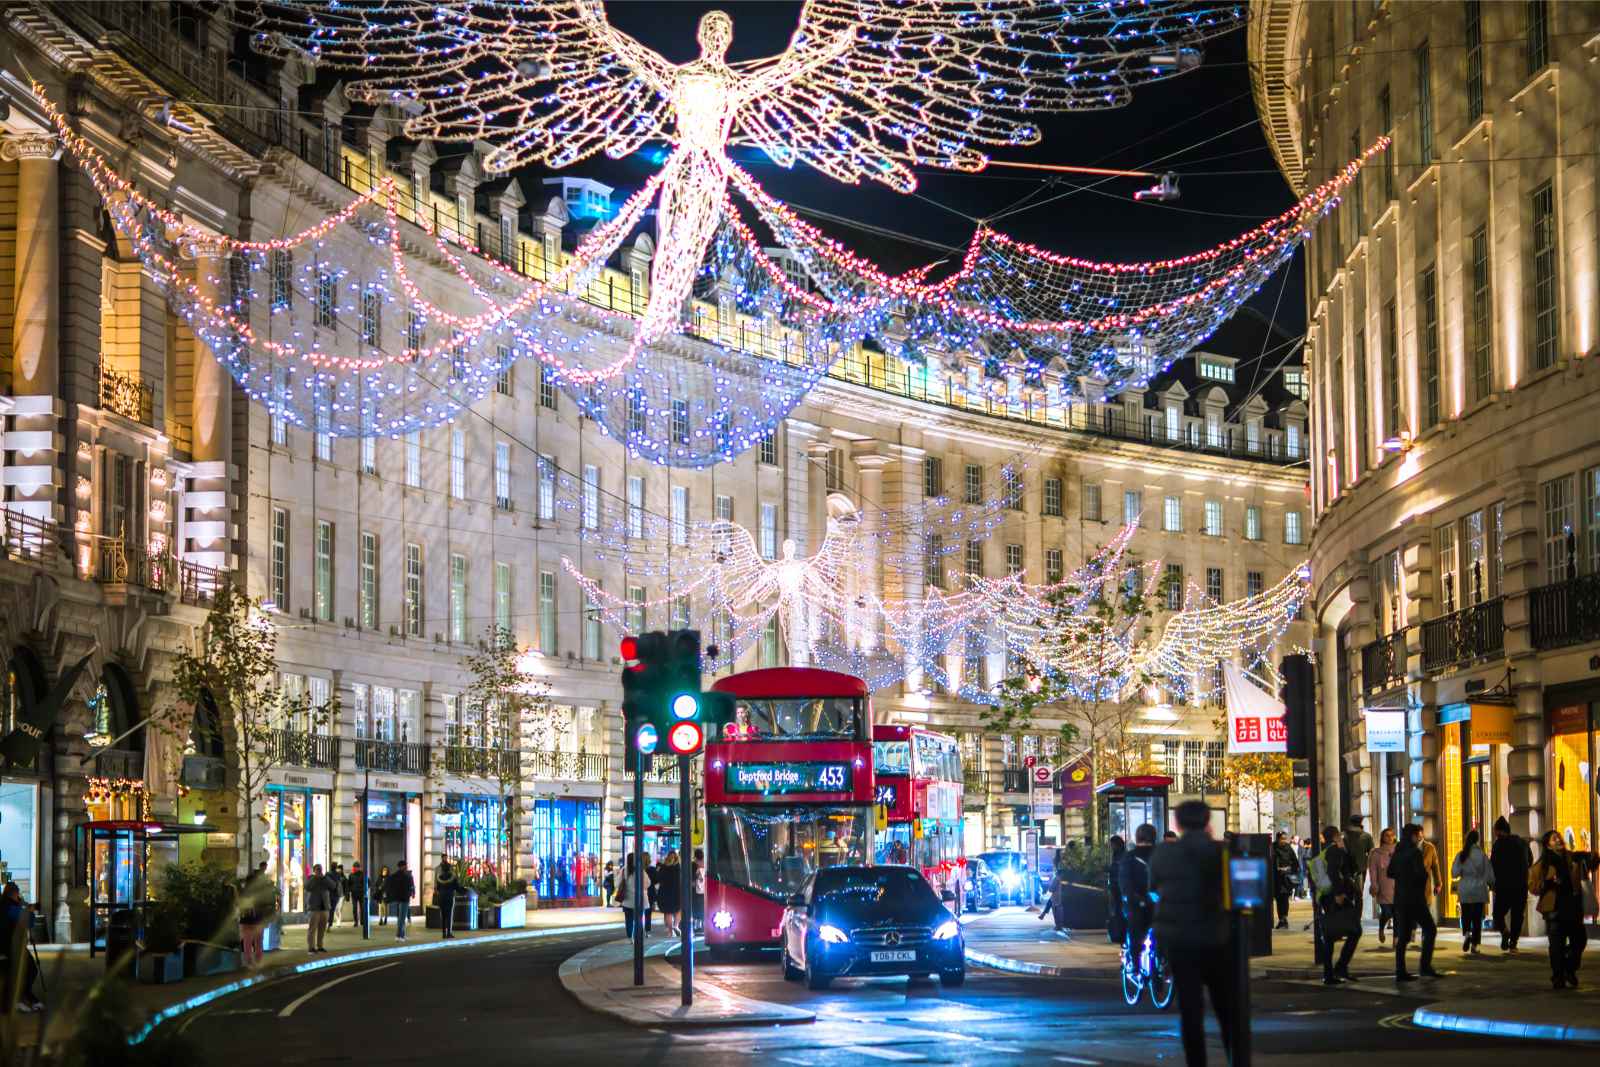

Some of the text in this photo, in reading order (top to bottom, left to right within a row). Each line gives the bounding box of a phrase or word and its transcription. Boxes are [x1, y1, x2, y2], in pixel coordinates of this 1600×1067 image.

[1268, 719, 1287, 729] UN
[738, 769, 800, 785] Deptford Bridge
[819, 767, 845, 786] 453
